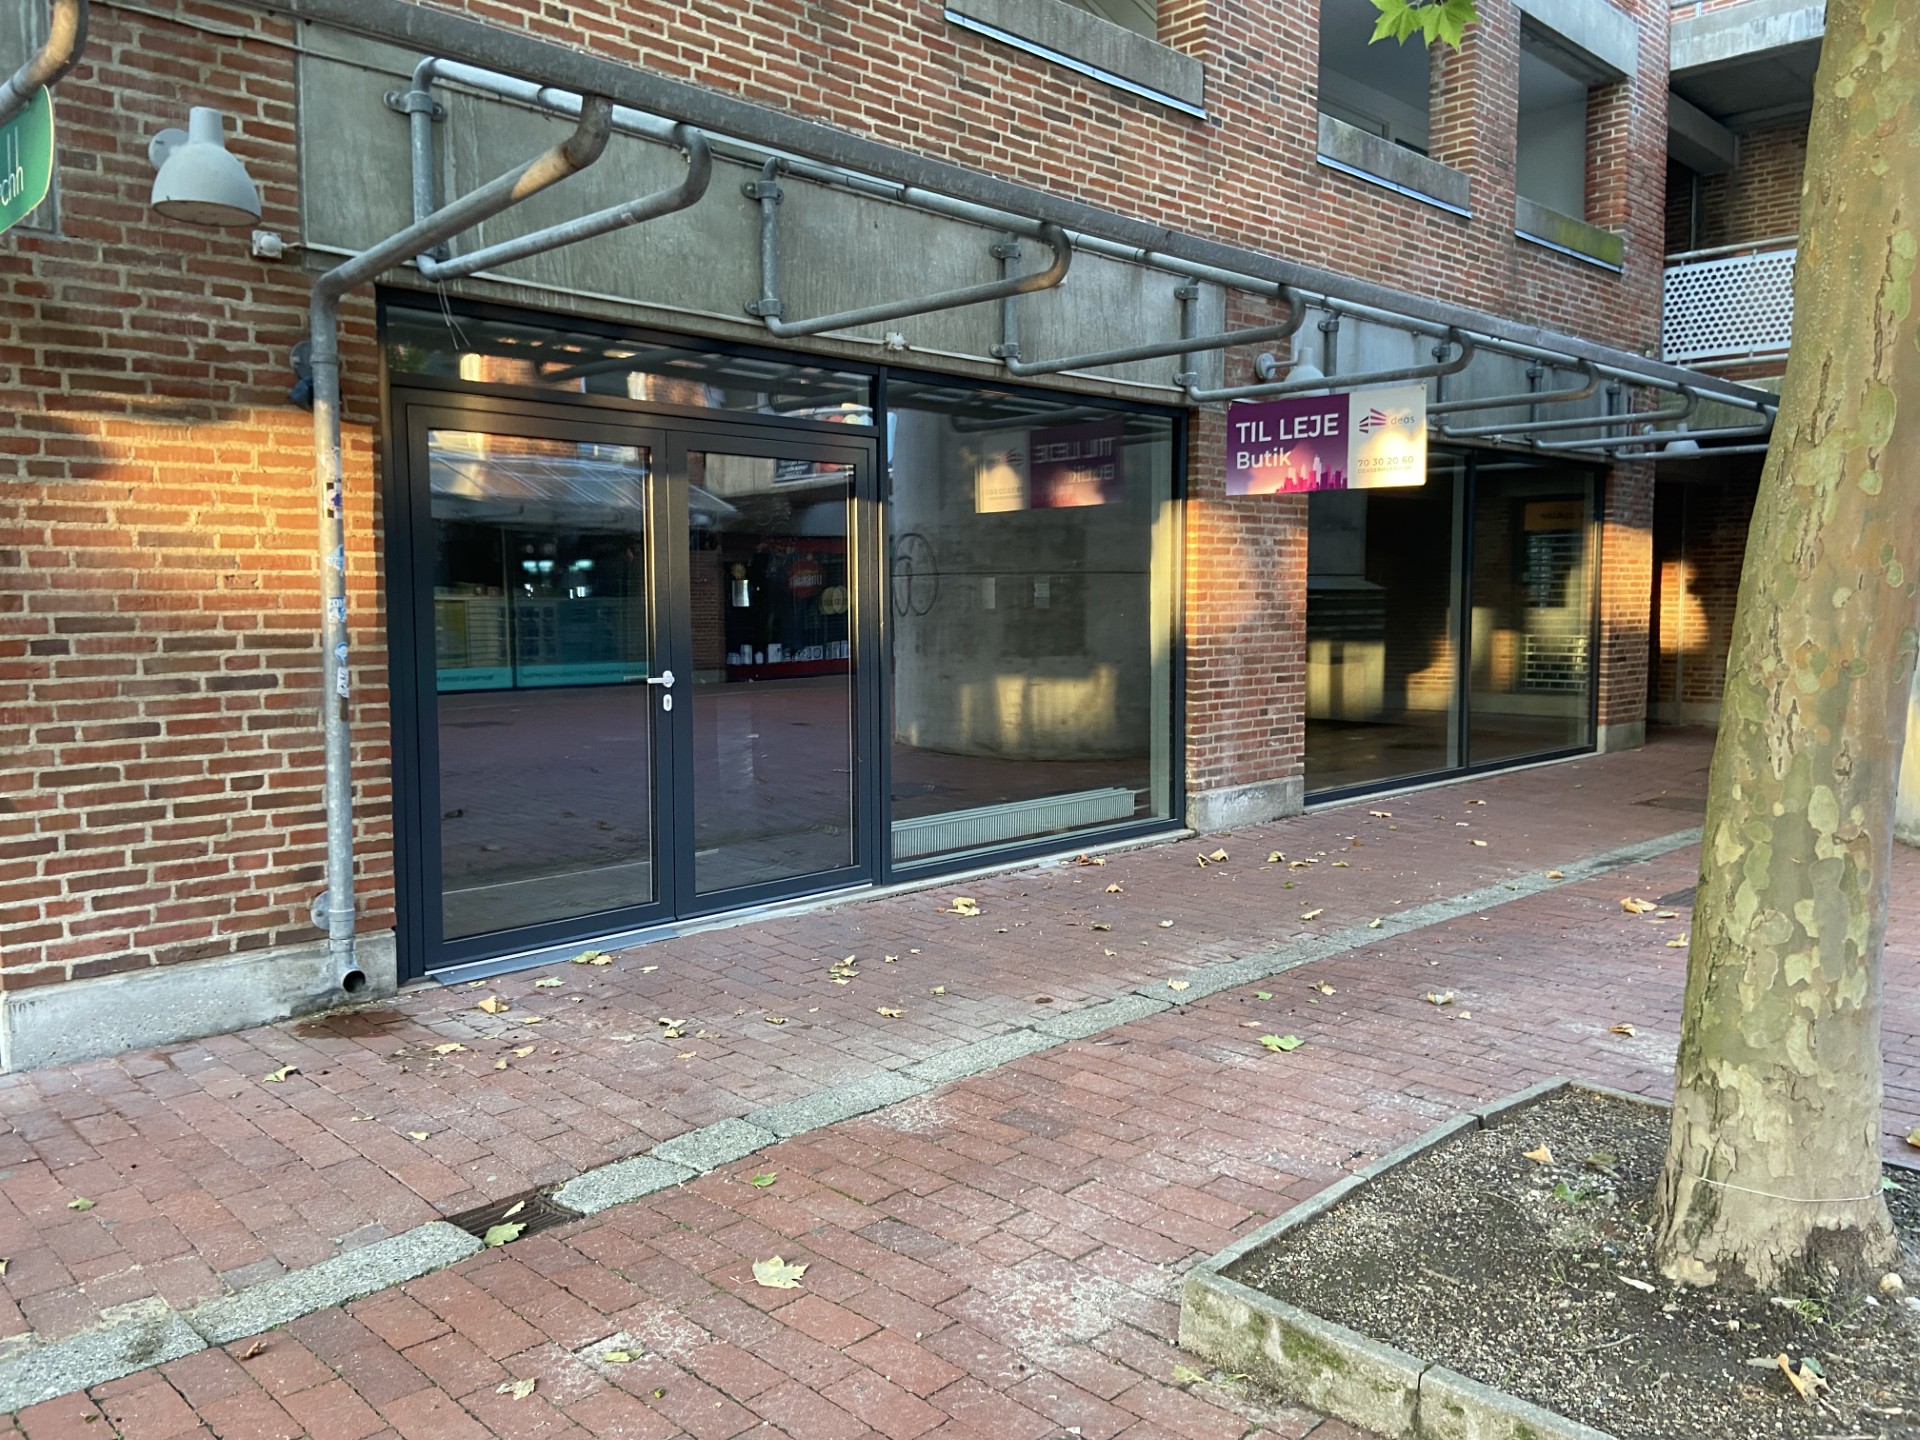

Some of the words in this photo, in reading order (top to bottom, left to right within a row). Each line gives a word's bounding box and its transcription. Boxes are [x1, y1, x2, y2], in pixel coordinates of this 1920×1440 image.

[1235, 422, 1272, 444] TIL
[1279, 413, 1339, 440] LEJE
[1390, 416, 1415, 425] deas
[1236, 447, 1292, 470] Butik
[1357, 459, 1370, 467] 70
[1372, 457, 1385, 466] 30
[1387, 456, 1399, 465] 20
[1401, 455, 1414, 464] 60
